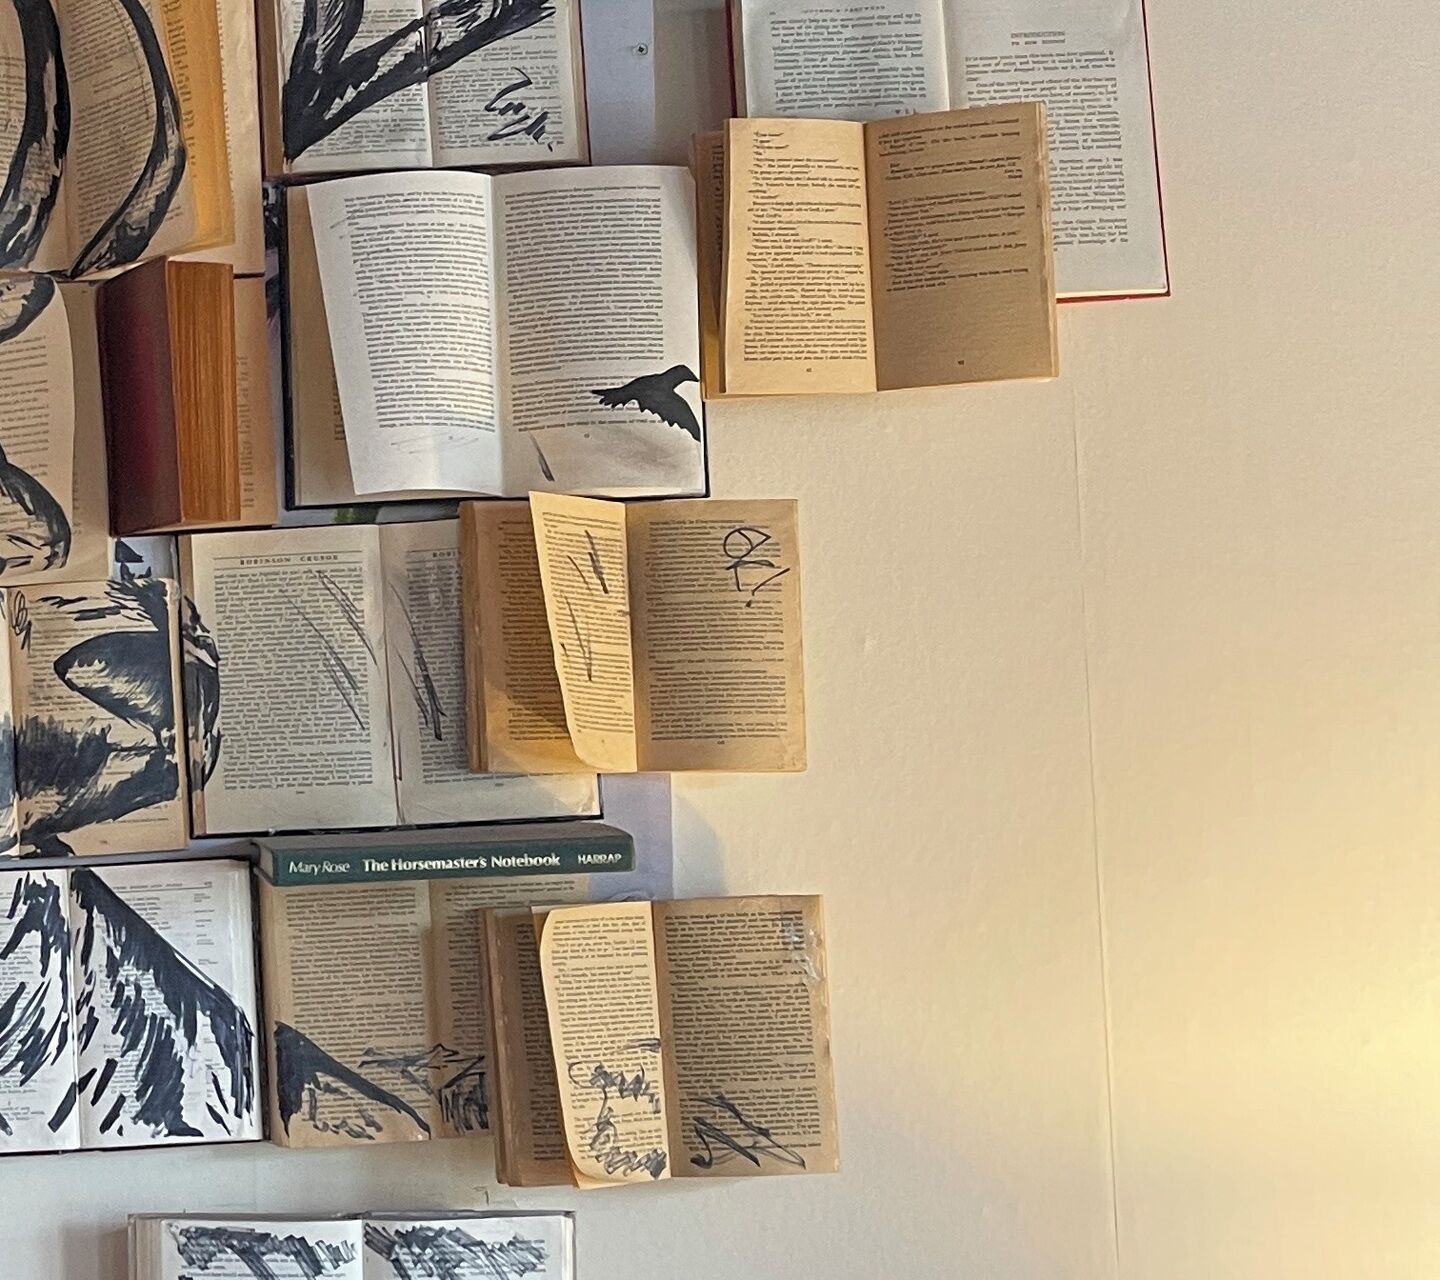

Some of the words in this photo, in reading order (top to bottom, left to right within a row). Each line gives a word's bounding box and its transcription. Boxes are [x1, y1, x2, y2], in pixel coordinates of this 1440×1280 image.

[289, 860, 321, 876] Mary
[321, 860, 350, 873] Rose
[362, 858, 389, 872] The
[390, 856, 487, 871] Horsemaster's
[491, 853, 561, 868] Notebook
[577, 853, 622, 865] HARRAP
